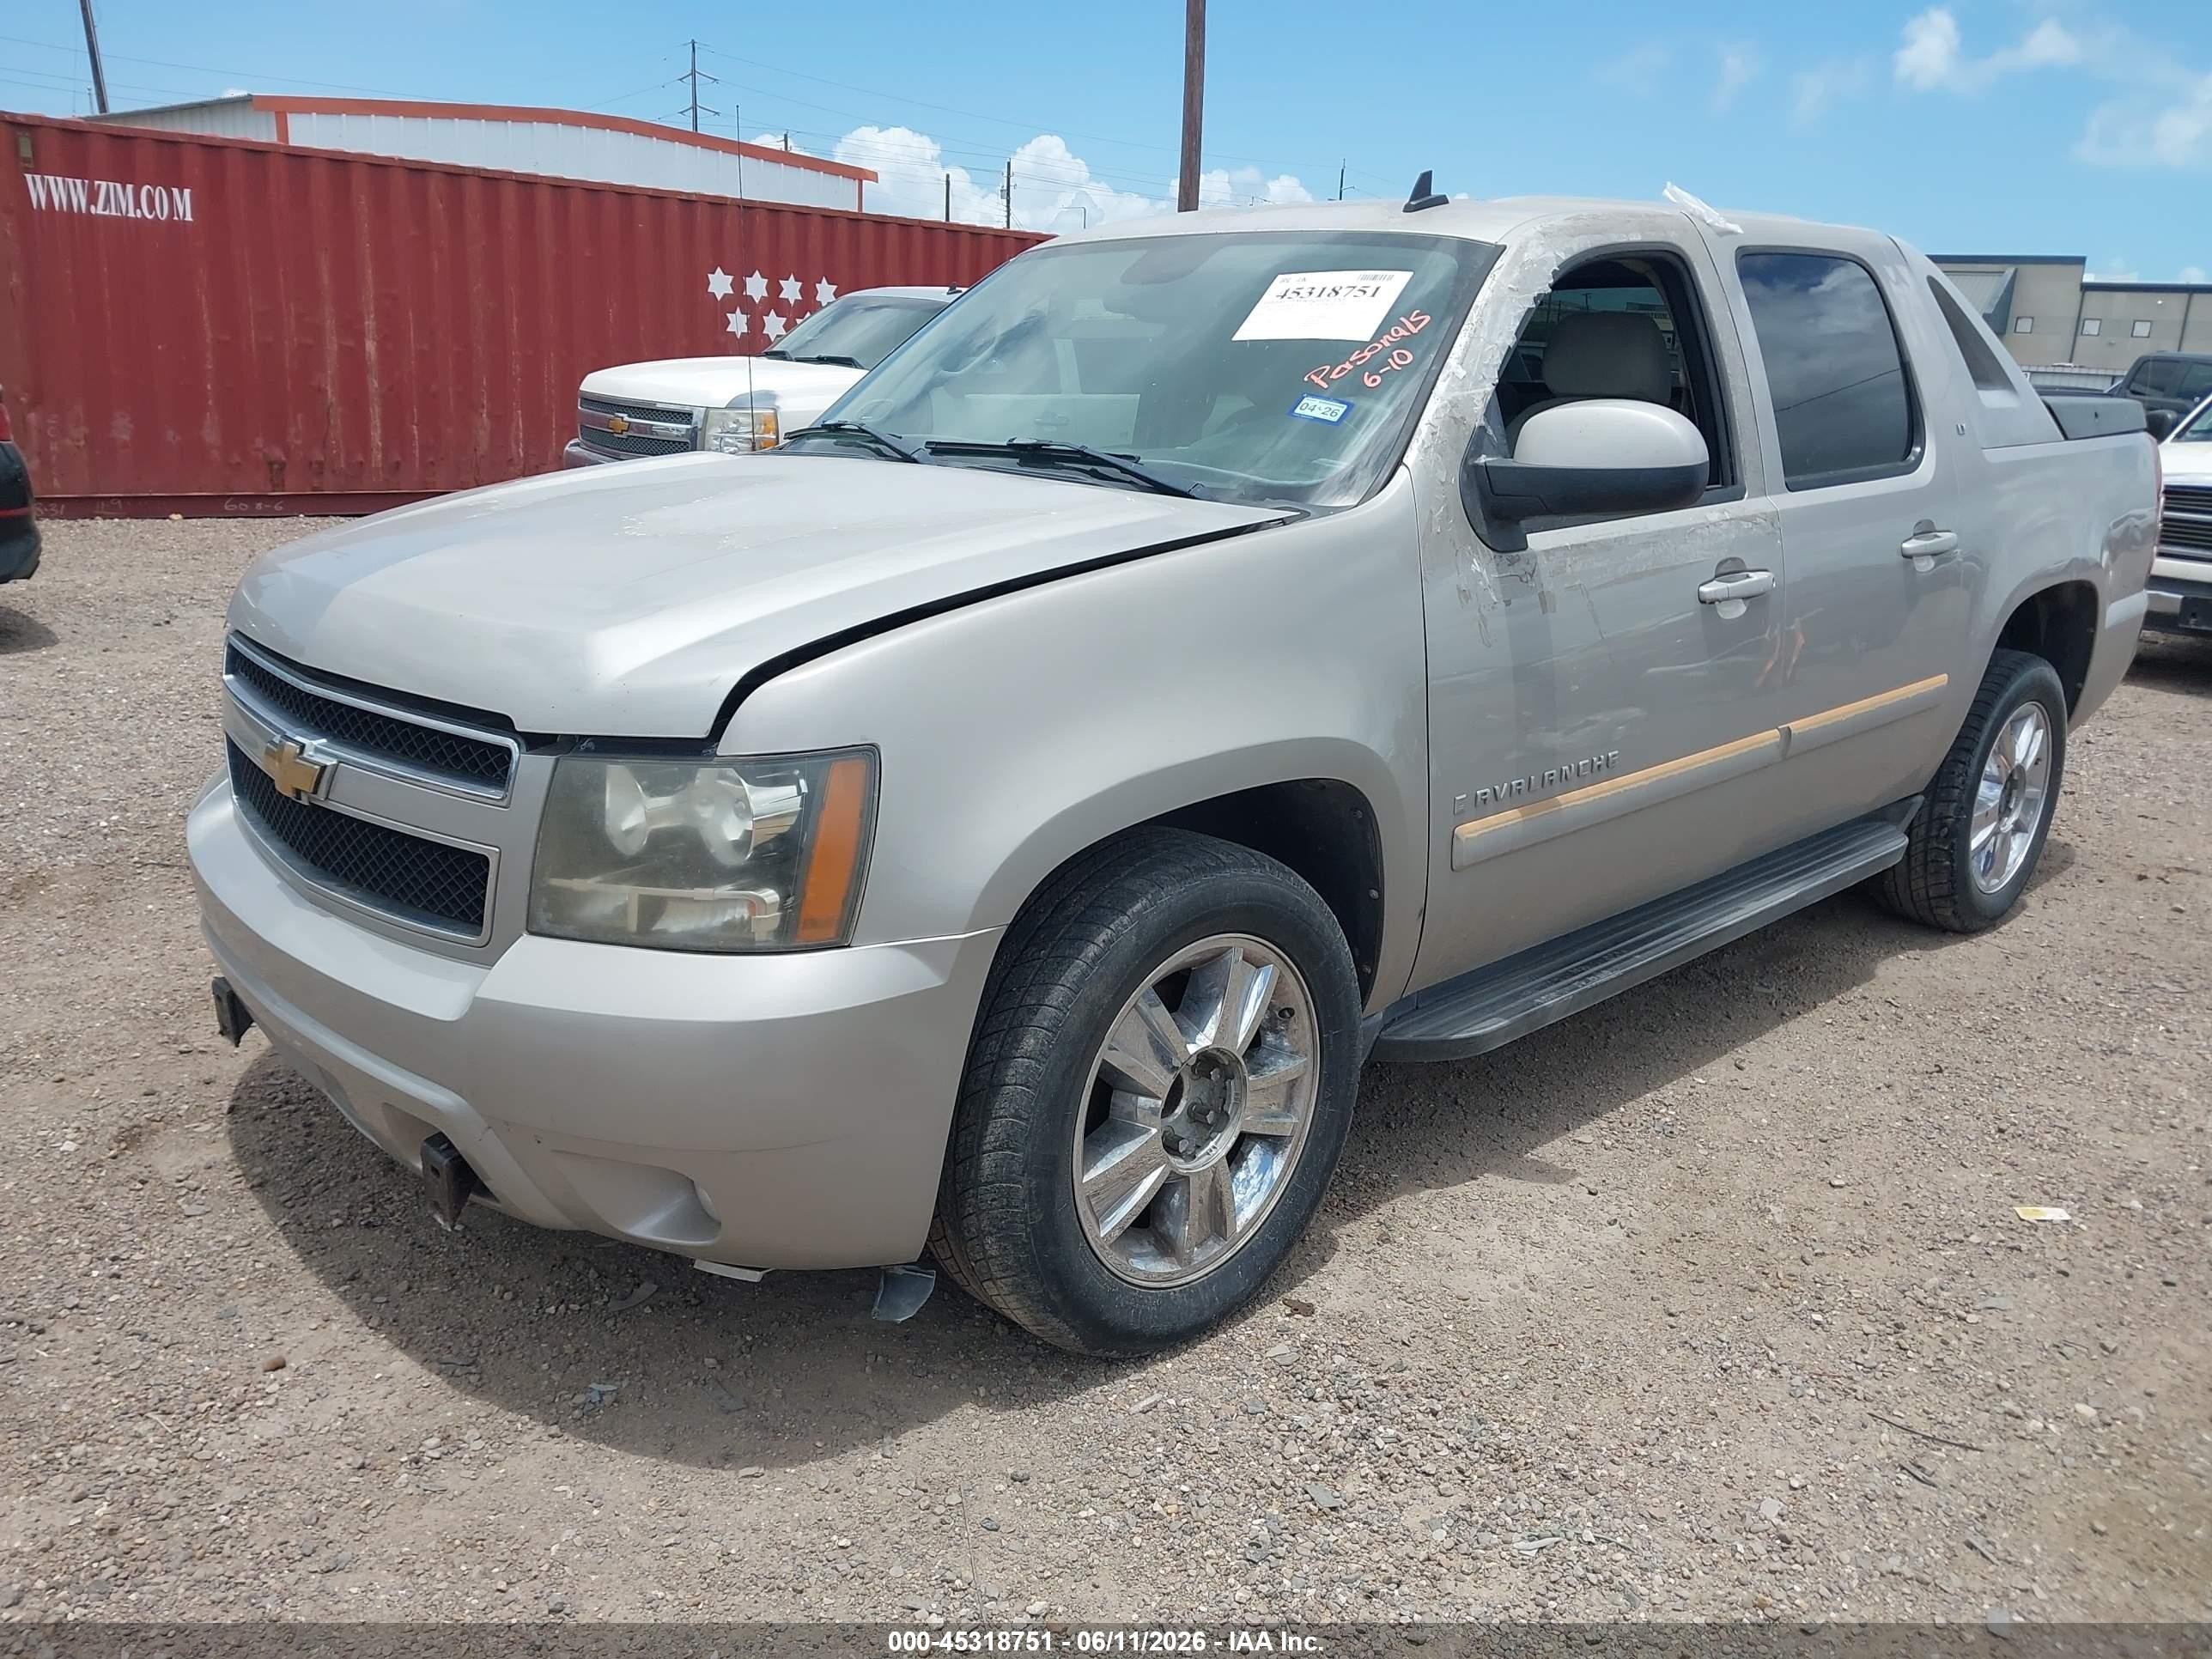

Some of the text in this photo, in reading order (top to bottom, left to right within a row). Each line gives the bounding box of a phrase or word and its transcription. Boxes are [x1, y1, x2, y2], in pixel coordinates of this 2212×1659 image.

[1275, 285, 1382, 300] 45318751
[1363, 349, 1414, 388] 6-10
[1474, 750, 1621, 808] AVALANCHE
